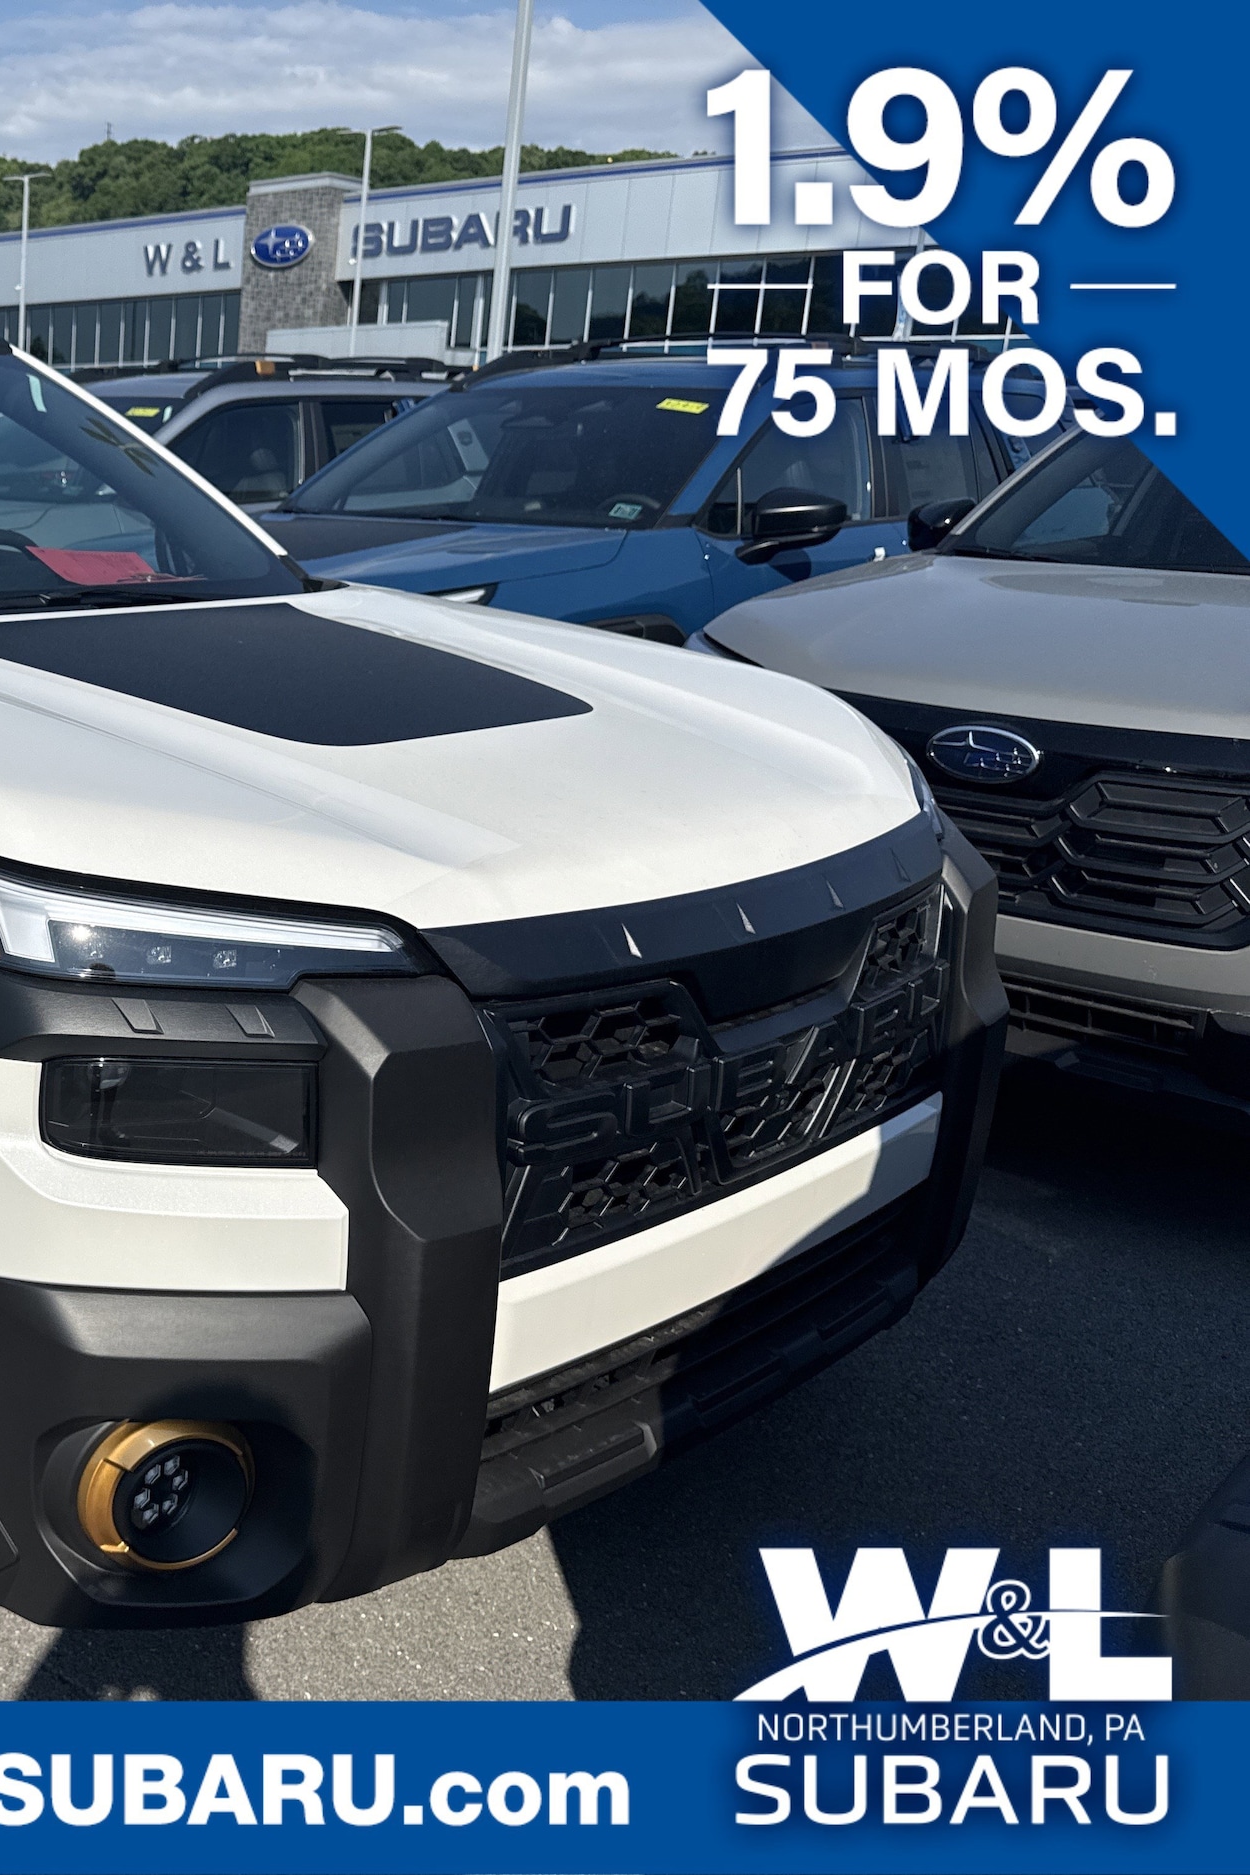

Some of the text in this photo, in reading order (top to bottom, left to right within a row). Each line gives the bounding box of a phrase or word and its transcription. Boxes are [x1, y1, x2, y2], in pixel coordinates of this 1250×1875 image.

[352, 204, 572, 259] SUBARU
[144, 238, 231, 276] W & L
